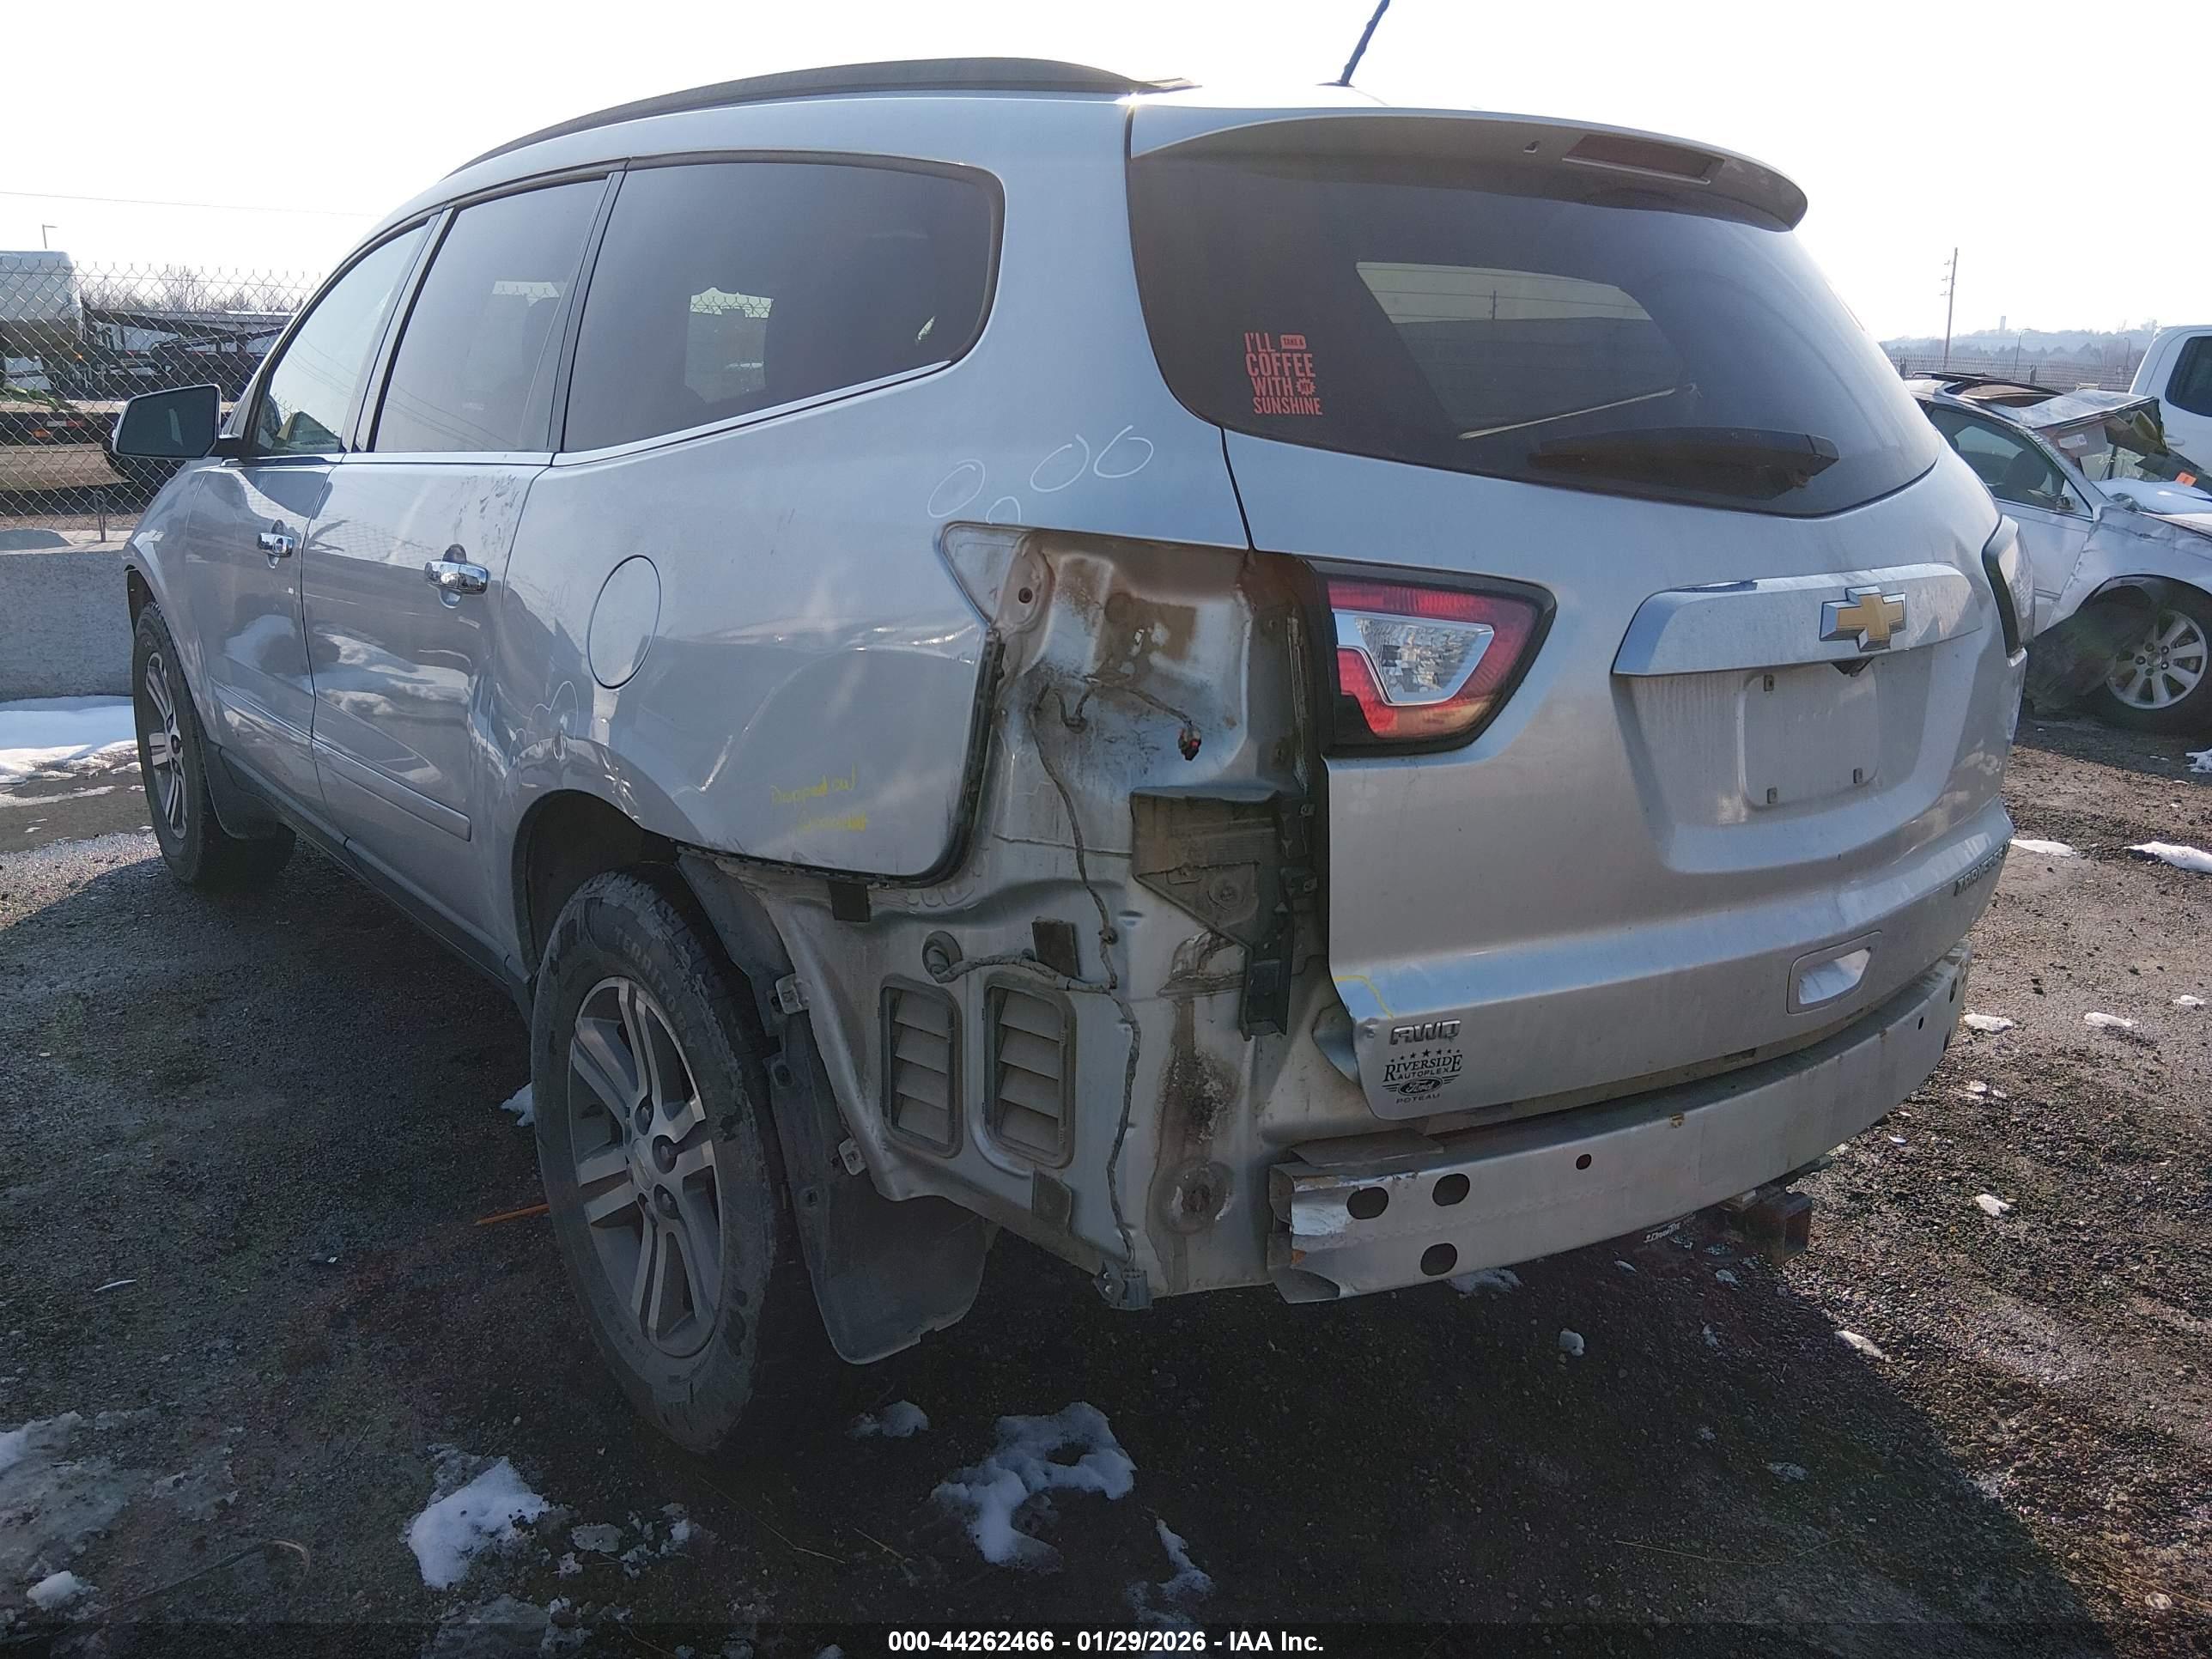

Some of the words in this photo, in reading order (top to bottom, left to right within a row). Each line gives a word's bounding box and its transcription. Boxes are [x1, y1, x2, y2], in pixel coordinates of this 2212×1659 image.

[1245, 332, 1276, 352] I'LL
[1246, 353, 1316, 377] COFFEE
[1250, 377, 1295, 396] WITH
[1253, 397, 1323, 415] SUNSHINE
[1389, 1019, 1462, 1045] AWD
[1383, 1054, 1462, 1082] RIVERSIDE
[1398, 1067, 1449, 1079] AUTOPLEX
[1395, 1093, 1441, 1103] POTEAU
